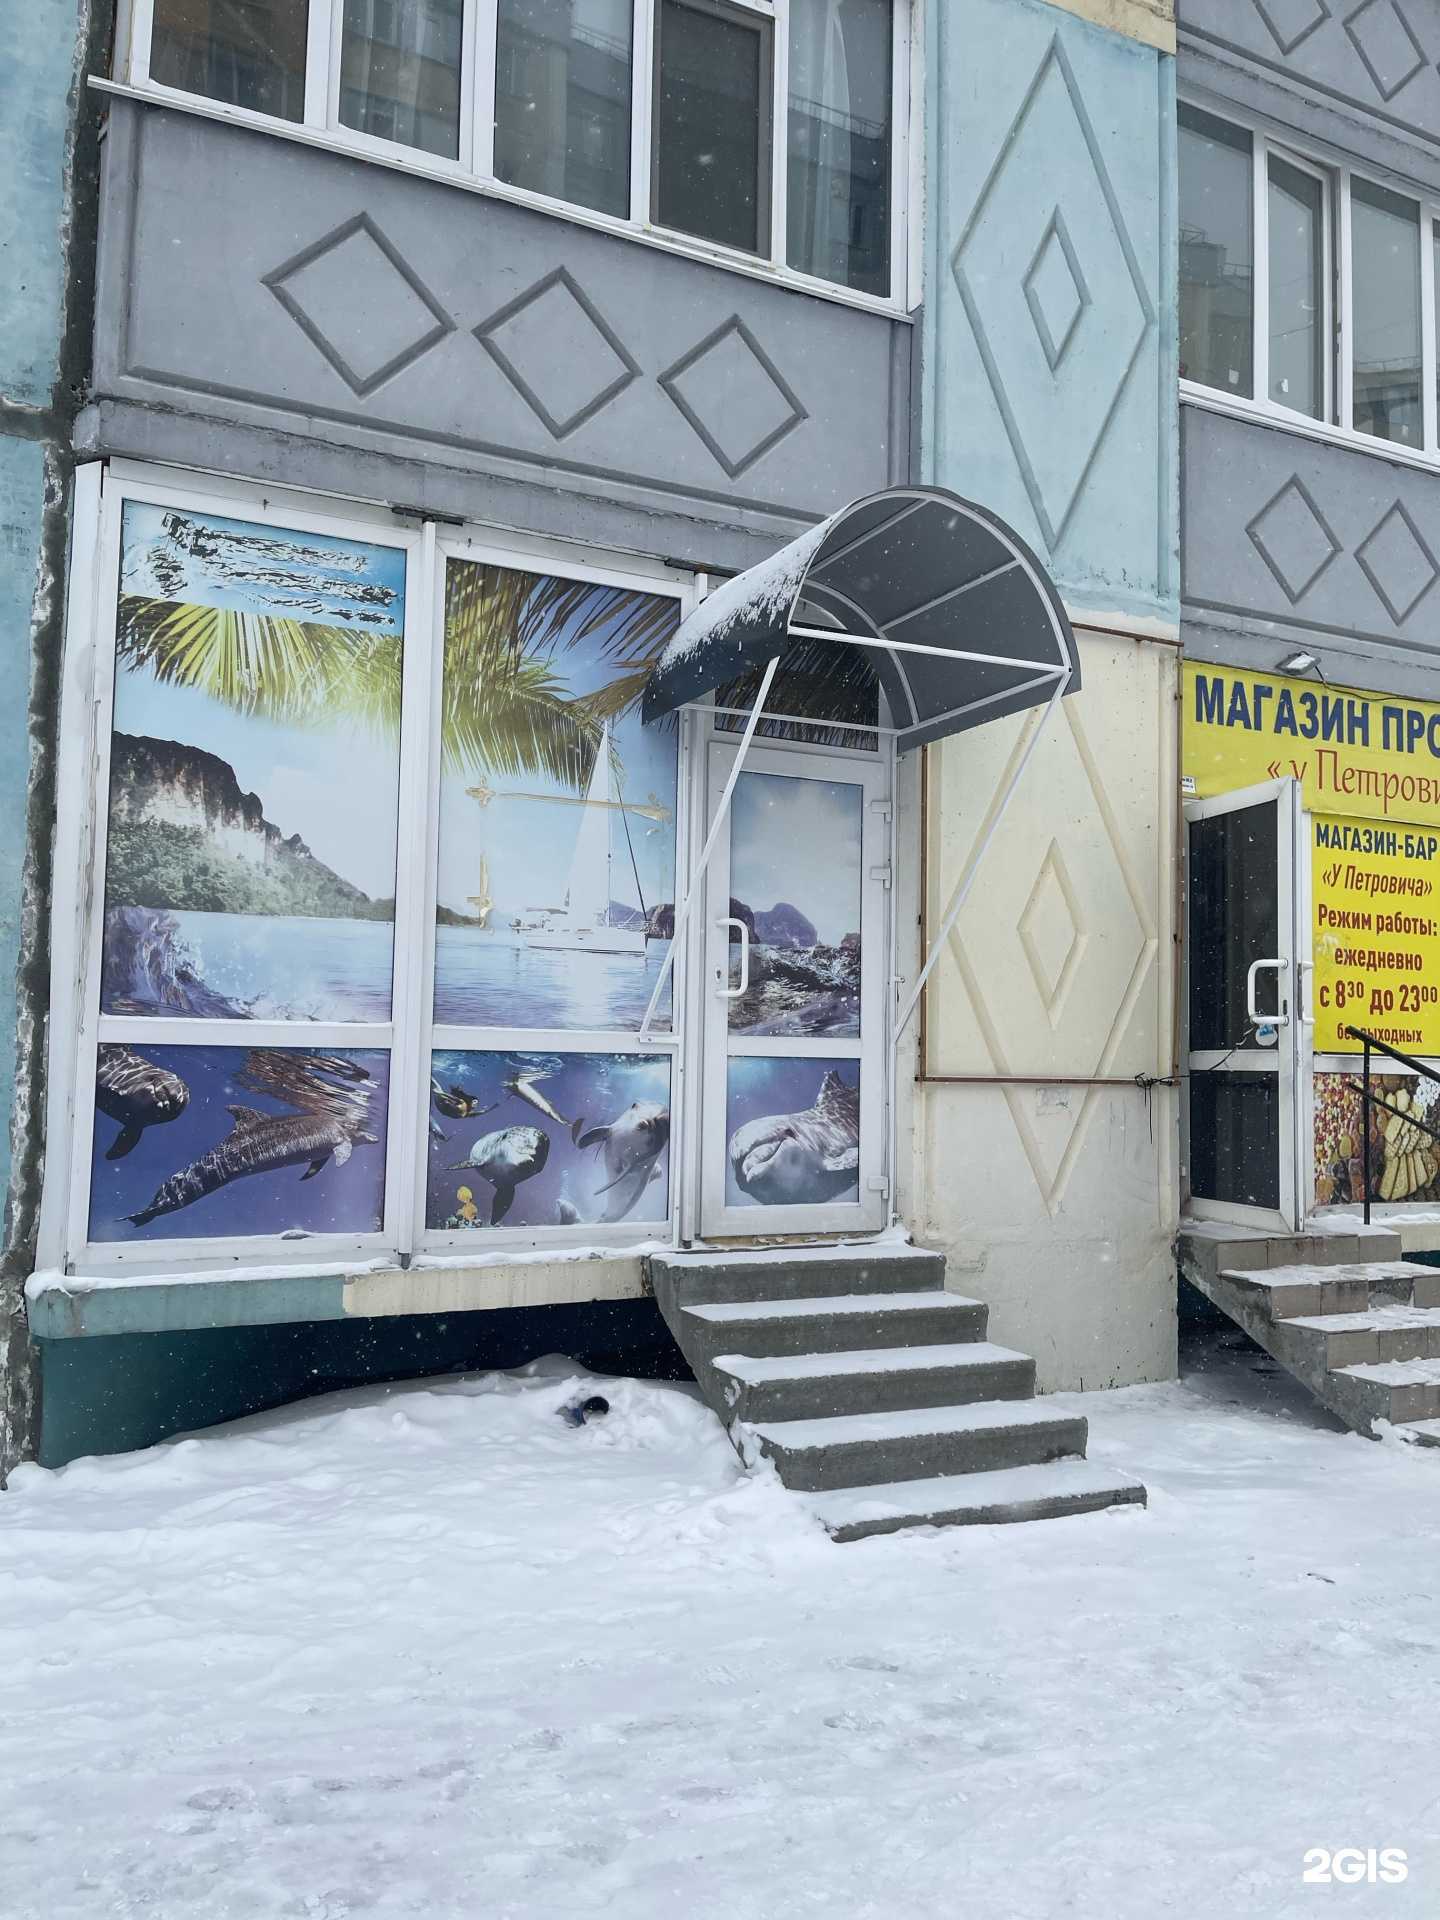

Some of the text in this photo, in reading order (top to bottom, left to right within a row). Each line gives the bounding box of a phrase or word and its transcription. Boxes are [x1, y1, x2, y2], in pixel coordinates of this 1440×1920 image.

[1195, 674, 1369, 747] МАГАЗИН
[1316, 822, 1438, 861] МАГАЗИН-БАР
[1322, 863, 1433, 898] «У Петровича»
[1318, 903, 1438, 936] Режим работы:
[1334, 947, 1423, 972] ежедневно
[1369, 988, 1394, 1016] до
[1337, 1022, 1357, 1041] бе
